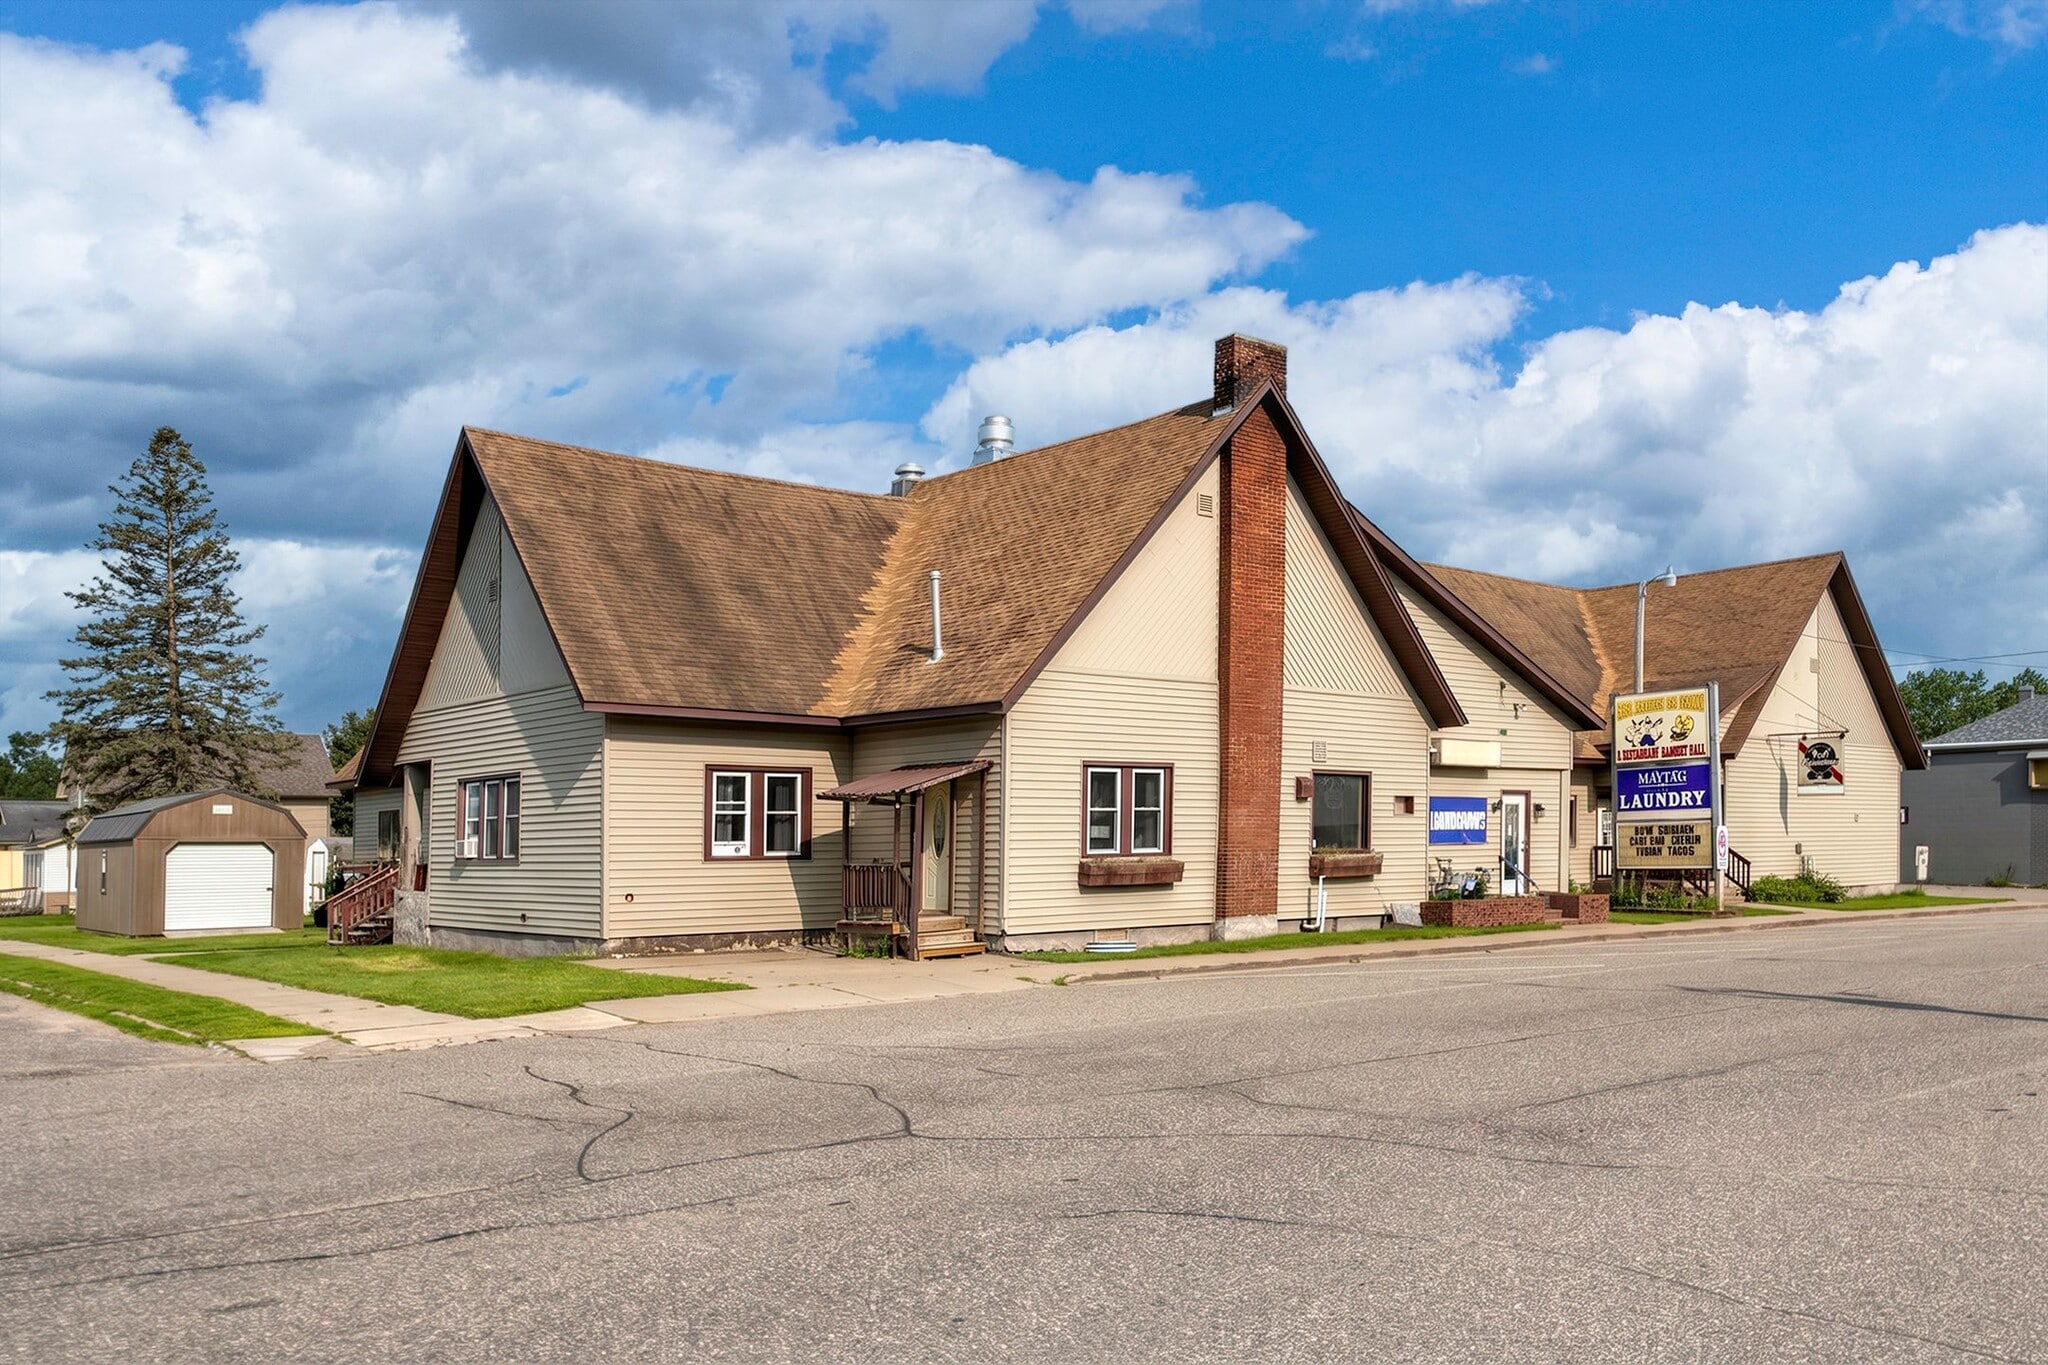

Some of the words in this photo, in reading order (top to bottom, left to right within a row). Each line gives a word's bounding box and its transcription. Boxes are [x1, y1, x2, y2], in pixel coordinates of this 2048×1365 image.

[1638, 770, 1687, 785] MAYTAG
[1620, 790, 1706, 809] LAUNDRY
[1668, 846, 1695, 856] TACOS
